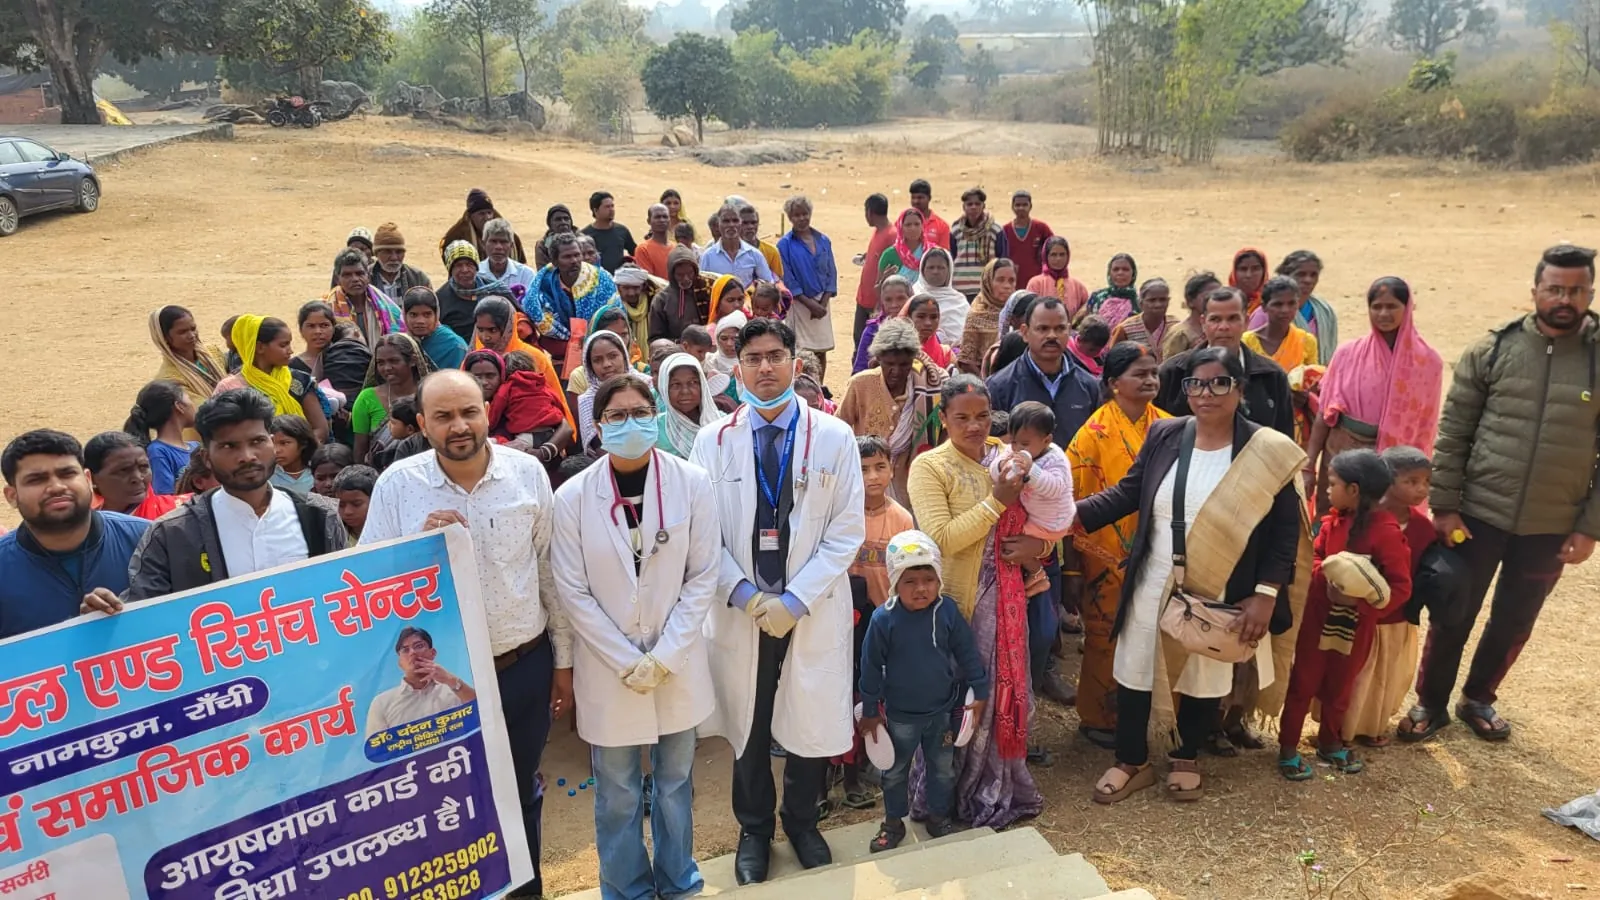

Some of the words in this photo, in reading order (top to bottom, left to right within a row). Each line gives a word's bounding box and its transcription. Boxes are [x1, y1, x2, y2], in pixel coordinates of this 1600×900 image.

[73, 634, 183, 709] एण्ड
[323, 564, 443, 637] सेन्टर
[31, 733, 251, 839] समाजिक
[259, 685, 357, 757] कार्य
[435, 705, 473, 728] कुमार
[160, 798, 337, 890] आयूषमान
[344, 761, 419, 813] कार्ड
[426, 745, 472, 785] की
[304, 814, 427, 881] उपलब्ध
[384, 831, 499, 899] 9123259802
